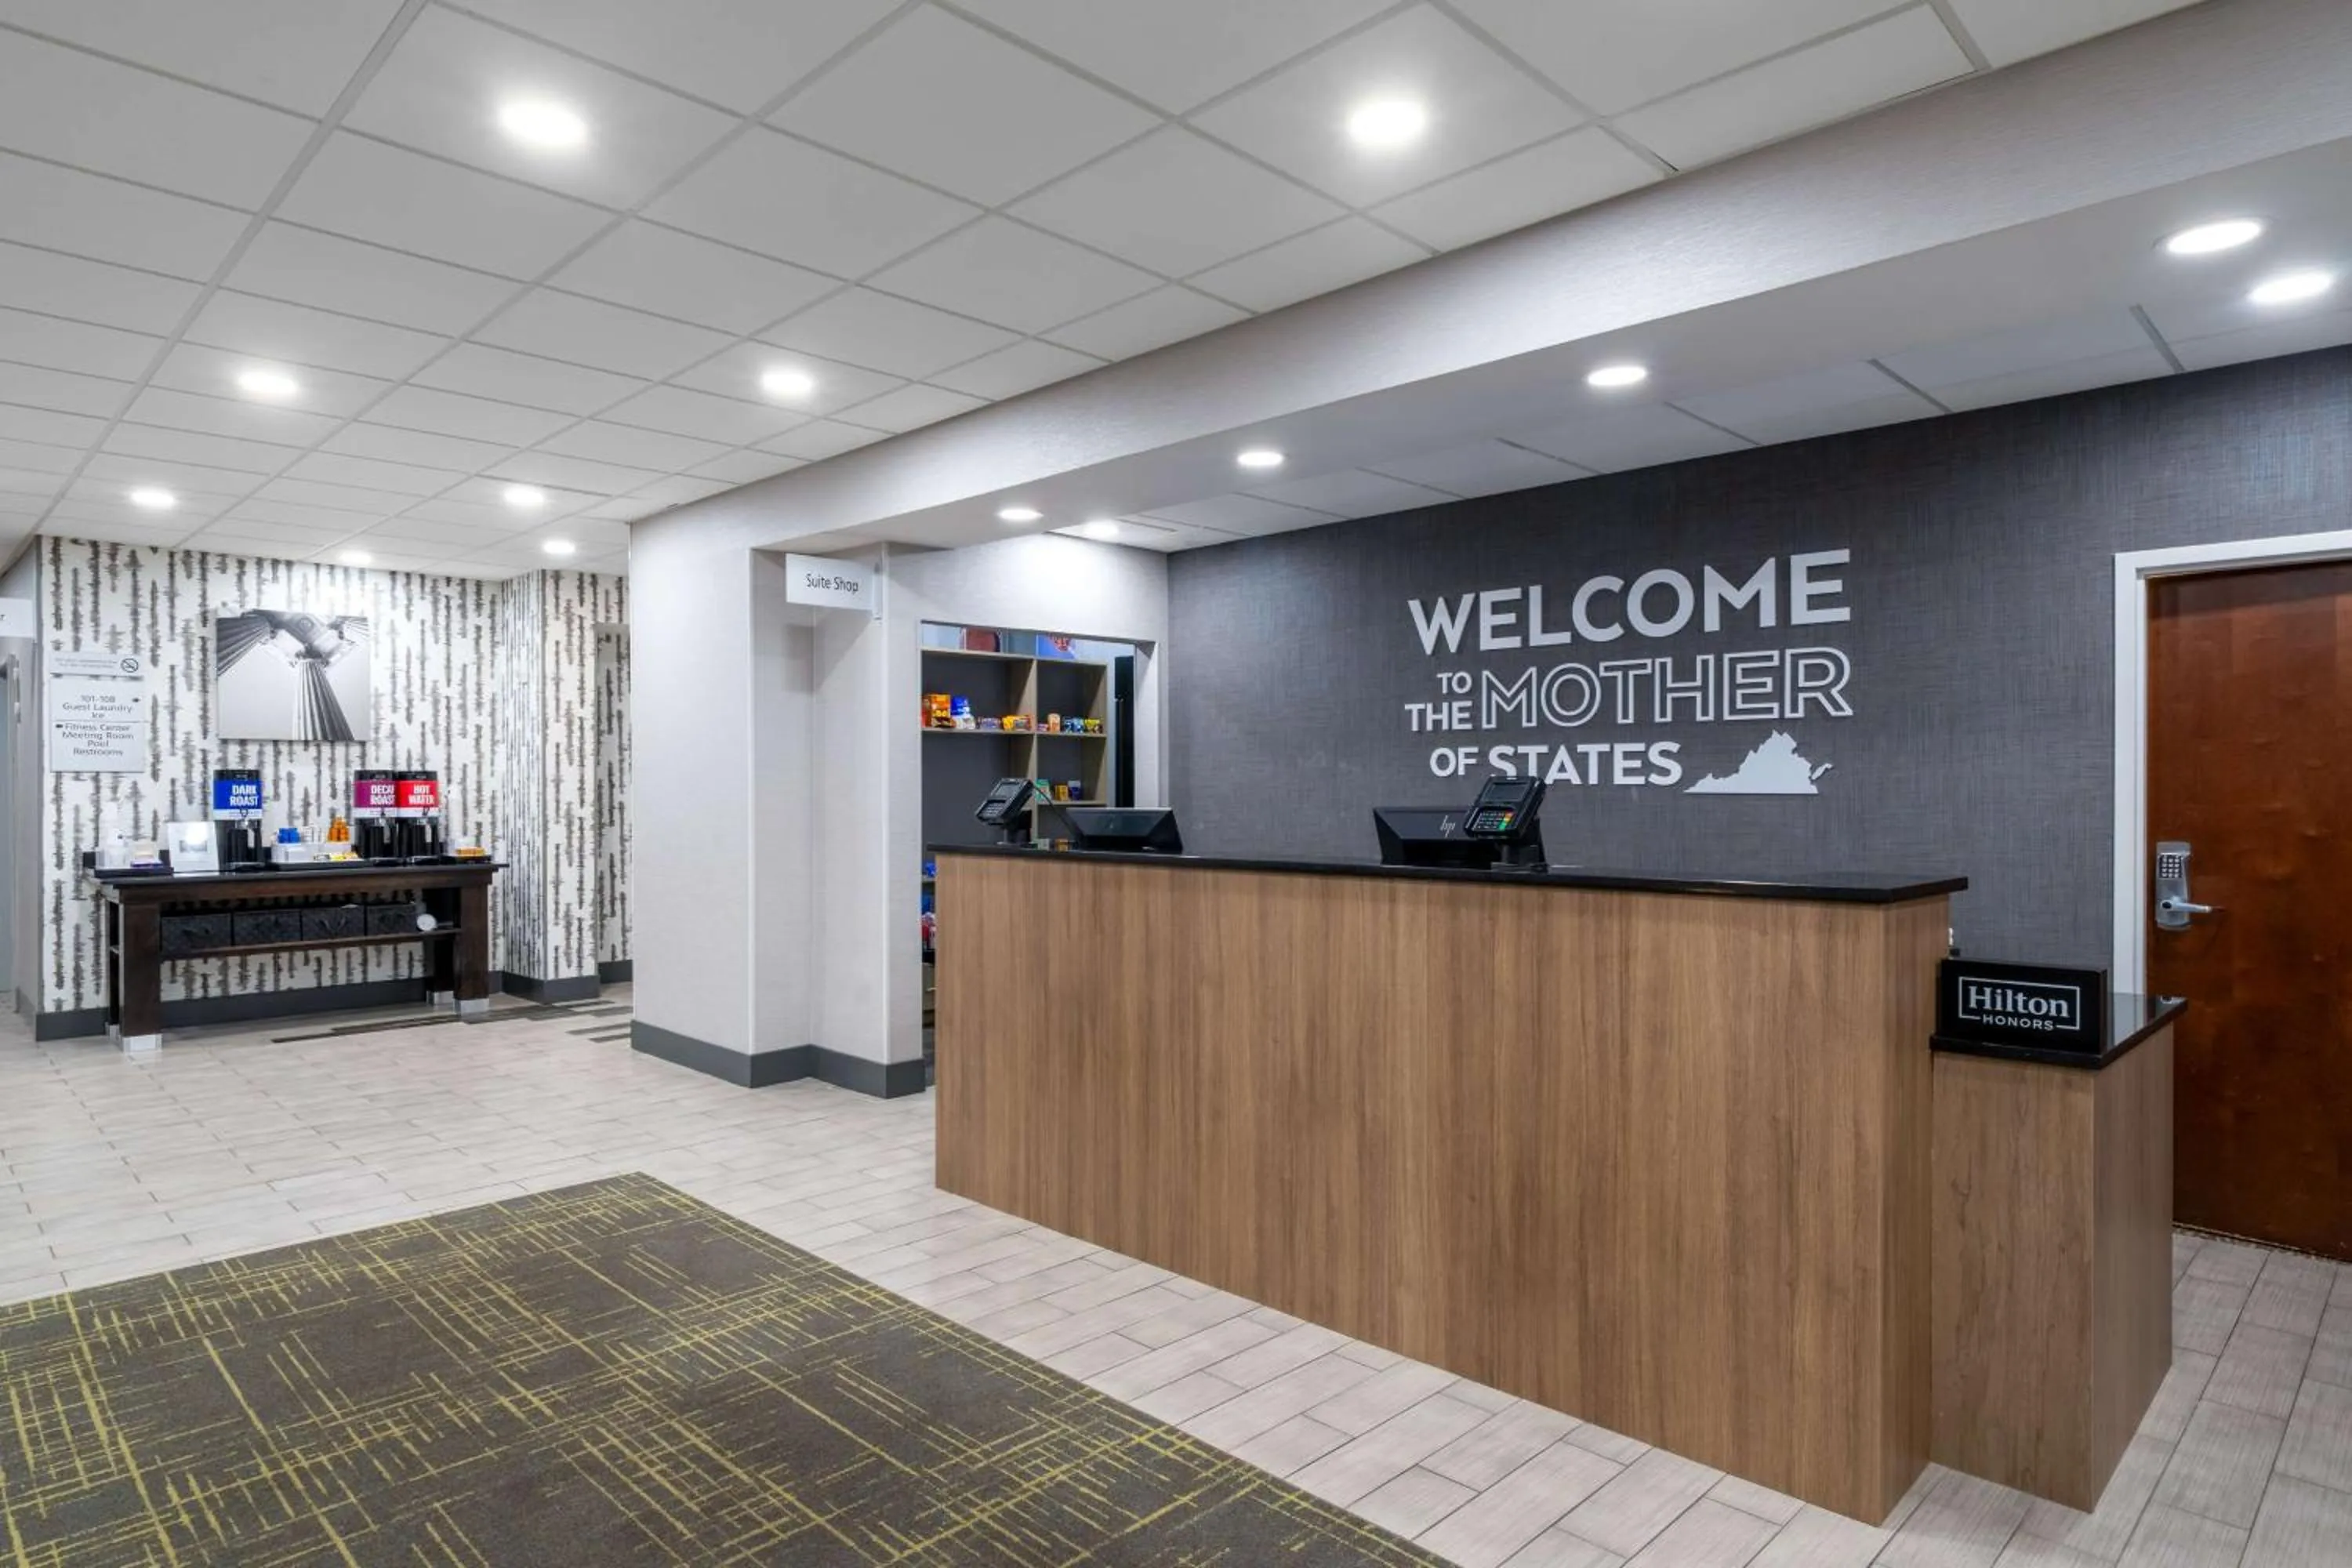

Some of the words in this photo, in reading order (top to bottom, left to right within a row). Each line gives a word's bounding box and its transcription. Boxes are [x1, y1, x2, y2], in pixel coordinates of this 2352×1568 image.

[805, 573, 831, 590] Suite
[833, 576, 859, 595] Shop
[1408, 548, 1851, 655] WELCOME
[1436, 671, 1472, 695] TO
[1482, 647, 1853, 729] MOTHER
[93, 703, 132, 713] Laundry
[1404, 700, 1473, 731] THE
[65, 723, 97, 731] Fitness
[73, 748, 124, 757] Restrooms
[1430, 746, 1479, 777] OF
[1489, 742, 1682, 786] STATES
[232, 785, 256, 795] DARK
[413, 784, 430, 794] HOT
[230, 796, 259, 807] ROAST
[408, 794, 434, 804] WATER
[1969, 985, 2070, 1018] Hilton
[1983, 1014, 2054, 1031] HONORS
